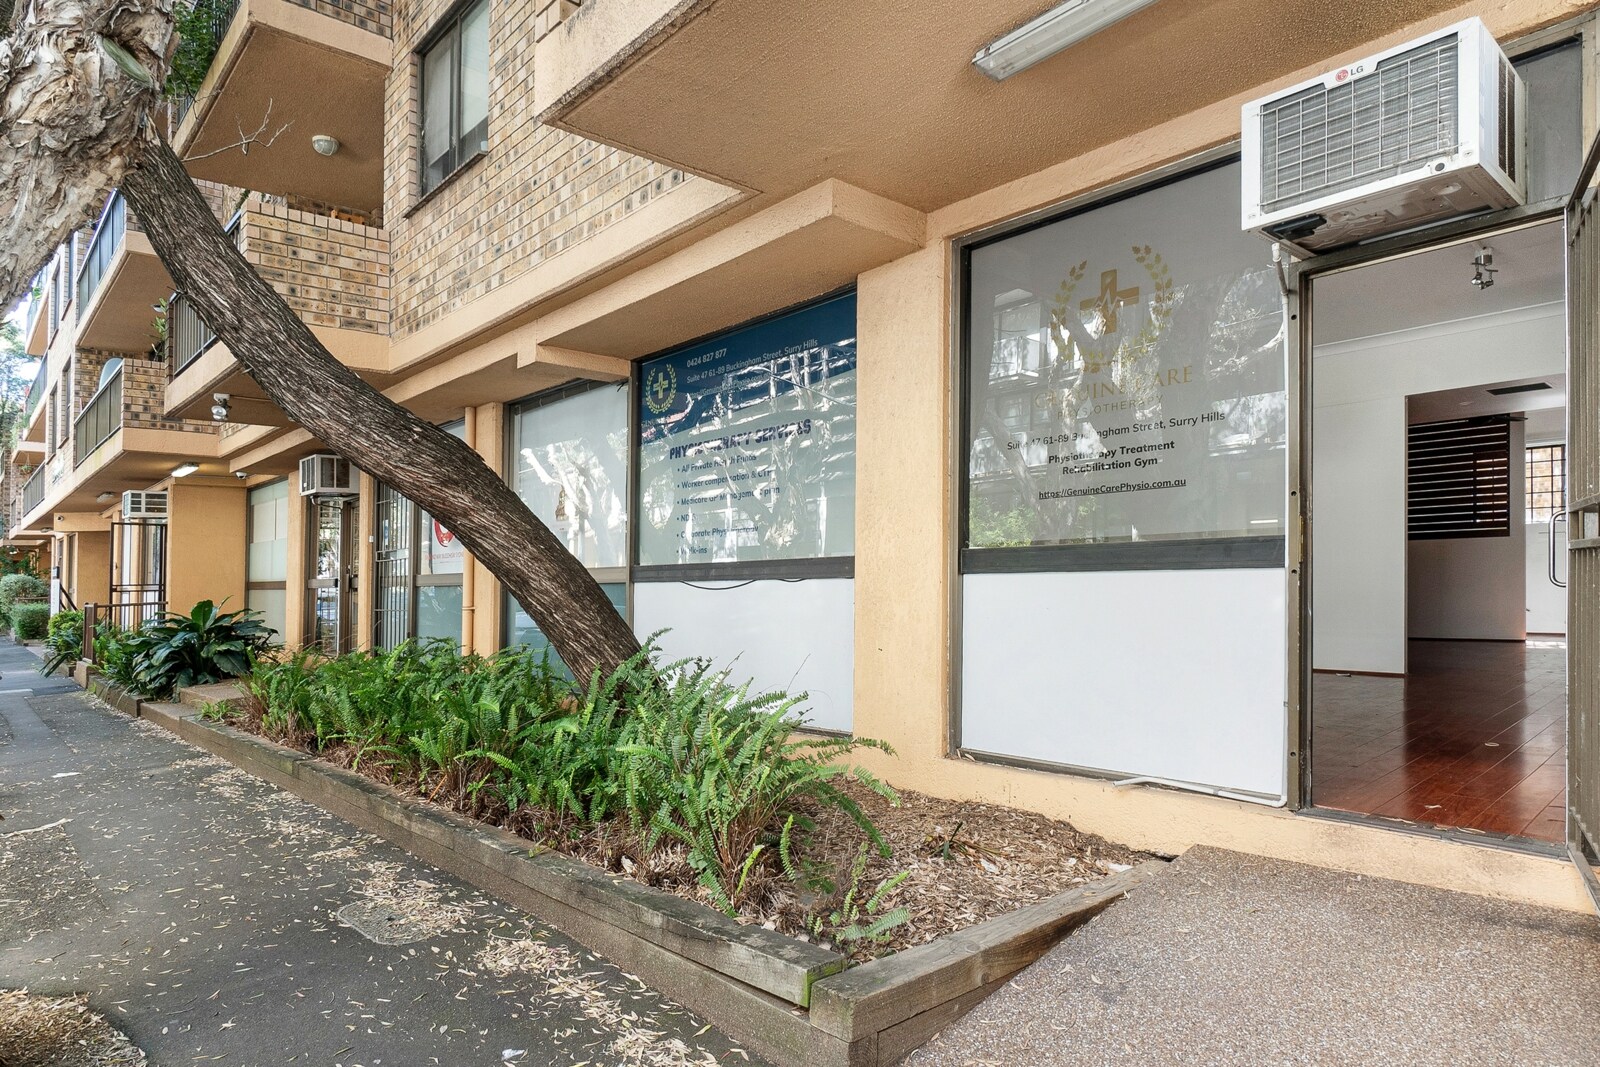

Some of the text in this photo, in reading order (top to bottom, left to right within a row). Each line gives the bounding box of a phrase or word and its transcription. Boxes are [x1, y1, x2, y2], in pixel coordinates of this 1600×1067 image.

[1350, 65, 1364, 76] LG
[686, 348, 727, 368] 0424 827 877
[686, 373, 700, 384] Suite
[701, 368, 708, 379] 47
[708, 364, 725, 377] 61-89
[725, 356, 762, 373] Buckingham
[784, 343, 801, 356] Surry
[803, 339, 818, 349] Hills
[1057, 395, 1164, 420] PYSIOTHERAPY
[1043, 433, 1069, 445] 61-89
[1071, 426, 1130, 443] Bucngham
[1133, 421, 1166, 433] Street,
[1169, 416, 1198, 427] Surry
[1201, 411, 1225, 423] Hills
[1048, 440, 1175, 464] Physiotheapy Treatment
[690, 461, 713, 472] Private
[1062, 457, 1158, 475] Rehabilitation Gym
[681, 479, 703, 489] Worker
[680, 545, 708, 555] Wlk-ins
